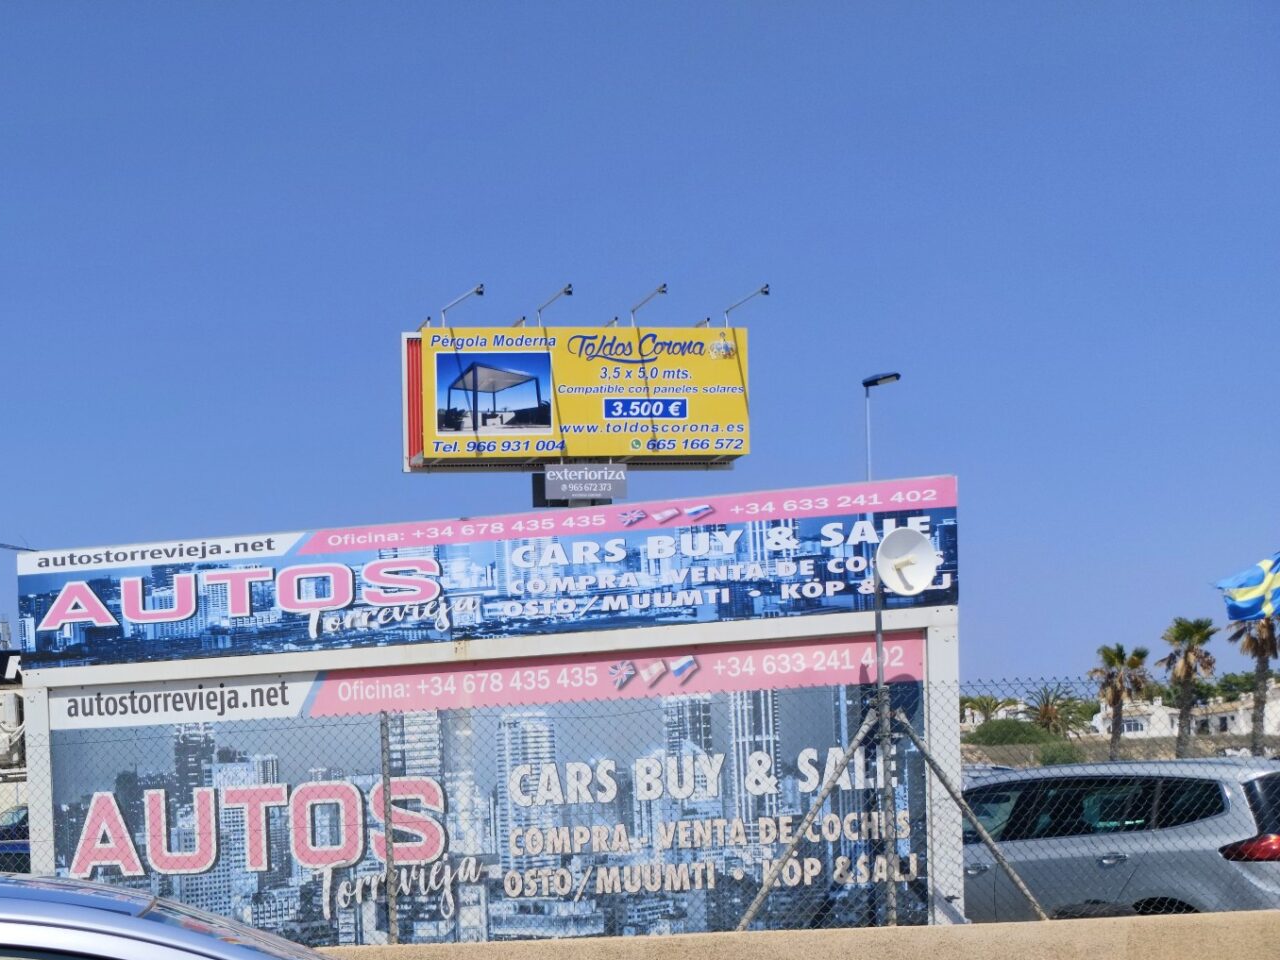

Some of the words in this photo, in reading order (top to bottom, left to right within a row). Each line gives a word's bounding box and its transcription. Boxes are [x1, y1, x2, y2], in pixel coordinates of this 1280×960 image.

[431, 334, 487, 349] Pérgola
[493, 335, 556, 347] Moderna
[638, 333, 705, 357] Corona
[600, 367, 621, 381] 3,5
[625, 370, 633, 379] x
[637, 367, 659, 380] 5,0
[662, 367, 693, 379] mts.
[558, 384, 625, 395] Compatible
[628, 385, 650, 394] con
[654, 384, 699, 395] paneles
[702, 383, 745, 394] solares
[611, 401, 664, 417] 3.500
[668, 401, 682, 417] €
[559, 421, 745, 434] www.toldoscorona.es
[433, 441, 461, 453] Tel.
[466, 441, 496, 453] 966
[501, 440, 530, 452] 931
[535, 439, 565, 452] 004
[646, 438, 677, 451] 665
[682, 438, 710, 451] 166
[714, 438, 744, 450] 572
[546, 466, 626, 481] exterioriza
[730, 502, 776, 515] +34
[783, 498, 829, 512] 633
[836, 493, 882, 508] 241
[889, 489, 937, 503] 402
[327, 530, 404, 547] Oficina:
[411, 524, 454, 539] +34
[461, 521, 504, 536] 678
[511, 518, 555, 532] 435
[562, 514, 606, 528] 435
[37, 537, 276, 568] autostorrevieja.net
[511, 538, 627, 568] CARS
[647, 529, 744, 560] BUY
[765, 526, 800, 551] &
[510, 571, 639, 595] COMPRA
[670, 562, 766, 585] VENTA
[776, 559, 815, 577] DE
[781, 578, 845, 600] KÖP
[36, 557, 442, 632] AUTOS
[713, 656, 756, 678] +34
[762, 652, 806, 675] 633
[813, 650, 854, 671] 241
[337, 679, 410, 701] Oficina:
[416, 675, 456, 697] +34
[462, 671, 504, 694] 678
[509, 668, 550, 691] 435
[556, 665, 599, 688] 435
[67, 681, 289, 717] autostorrevieja.net
[509, 759, 618, 807] CARS
[635, 753, 726, 801] BUY
[744, 750, 779, 796] &
[69, 776, 448, 879] AUTOS
[509, 823, 631, 857] COMPRA
[658, 815, 748, 850] VENTA
[758, 815, 793, 845] DE
